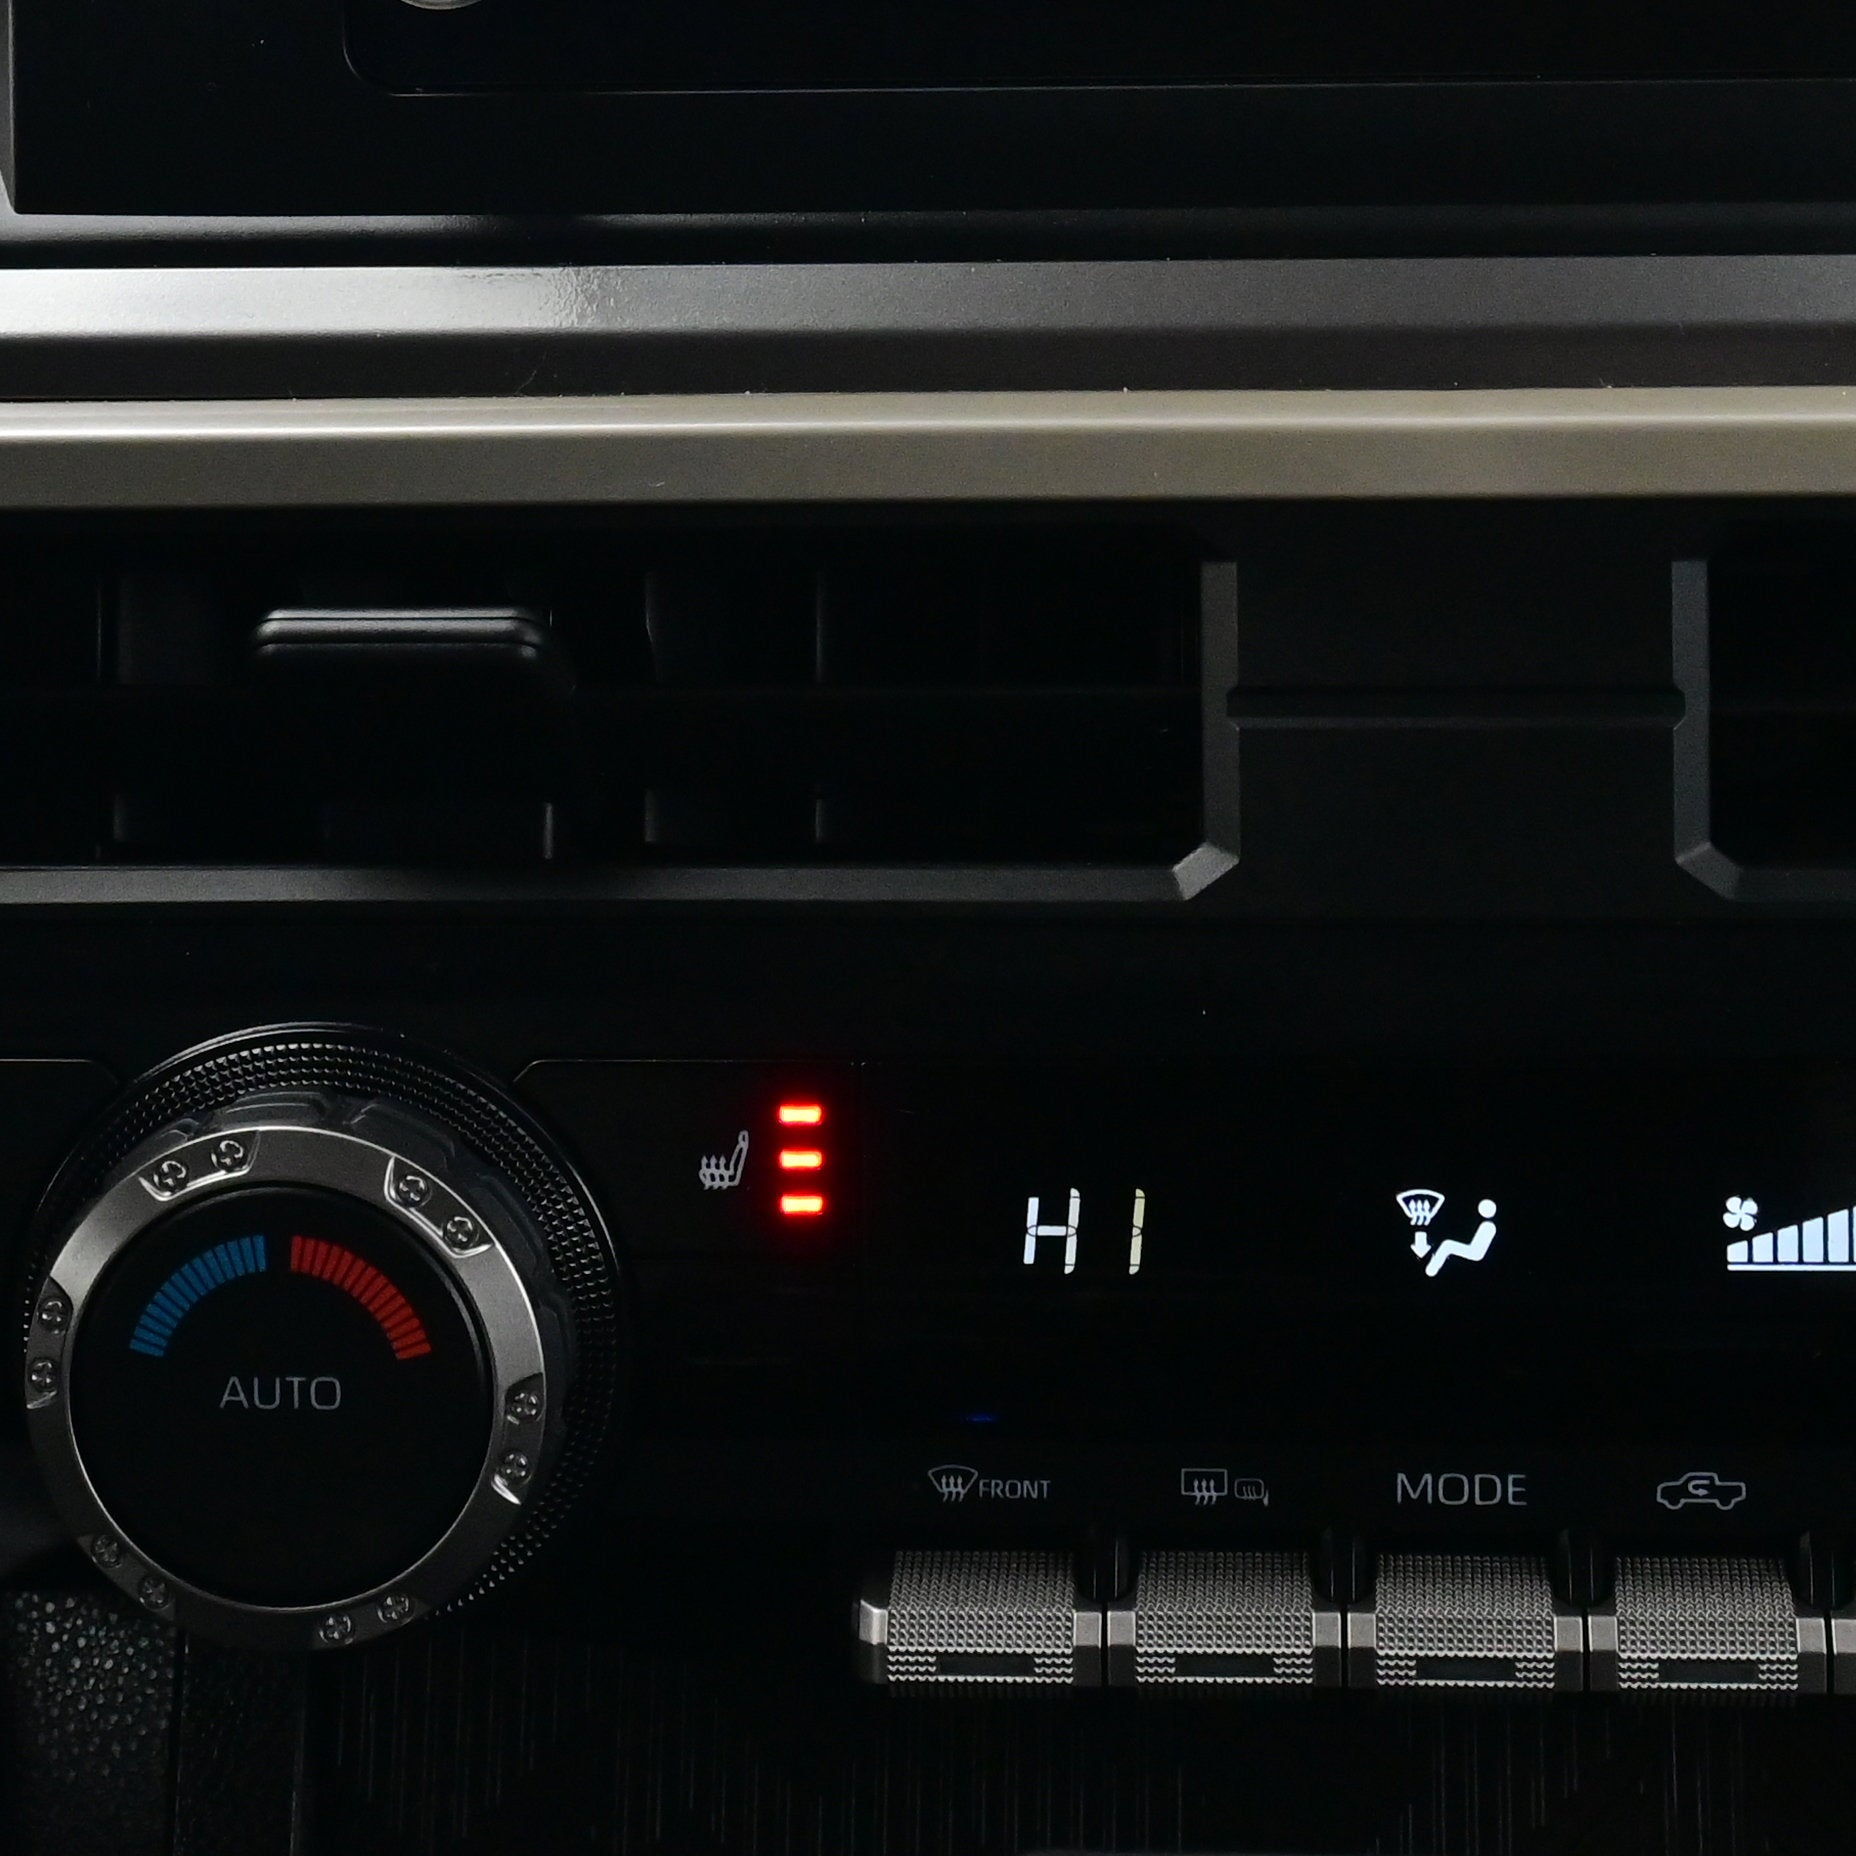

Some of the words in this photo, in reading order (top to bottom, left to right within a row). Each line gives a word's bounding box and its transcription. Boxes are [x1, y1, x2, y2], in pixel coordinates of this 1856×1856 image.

[220, 1377, 341, 1410] AUTO
[979, 1480, 1050, 1498] FRONT
[1397, 1473, 1526, 1505] MODE
